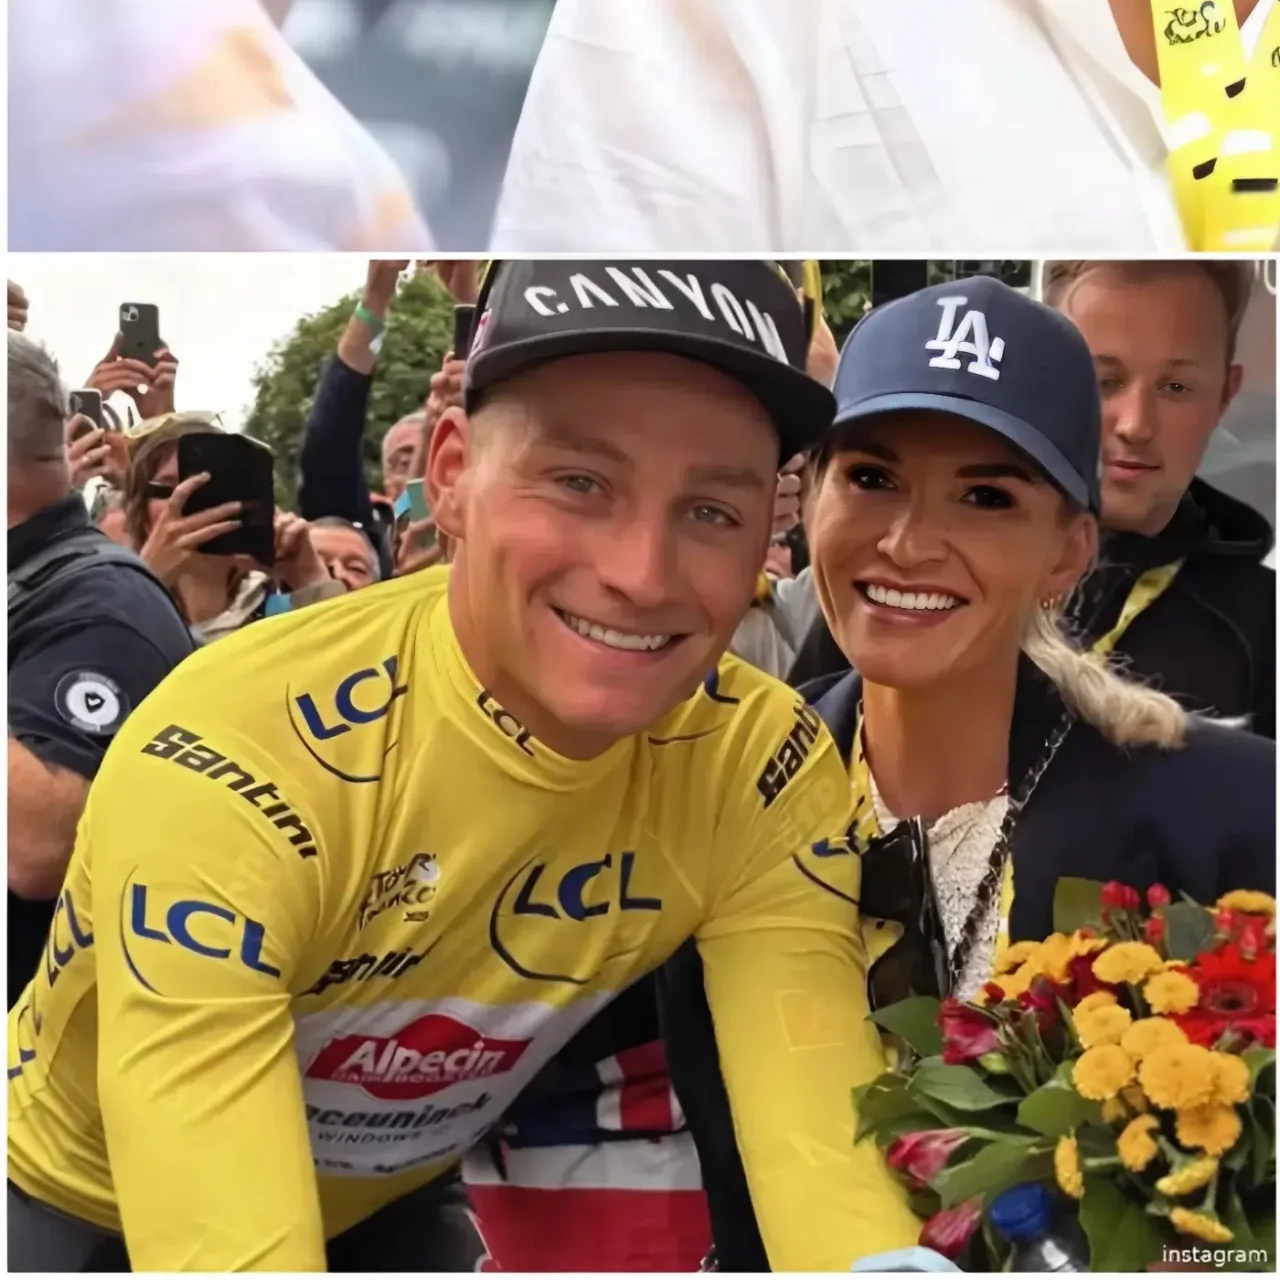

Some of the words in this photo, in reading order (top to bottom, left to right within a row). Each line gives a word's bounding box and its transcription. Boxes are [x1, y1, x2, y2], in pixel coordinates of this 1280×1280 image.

[523, 266, 789, 366] CANYON
[924, 296, 1005, 381] LA
[476, 689, 536, 757] LCL
[513, 852, 662, 922] LCL
[131, 883, 281, 978] LCL
[338, 1039, 506, 1082] Alpecin
